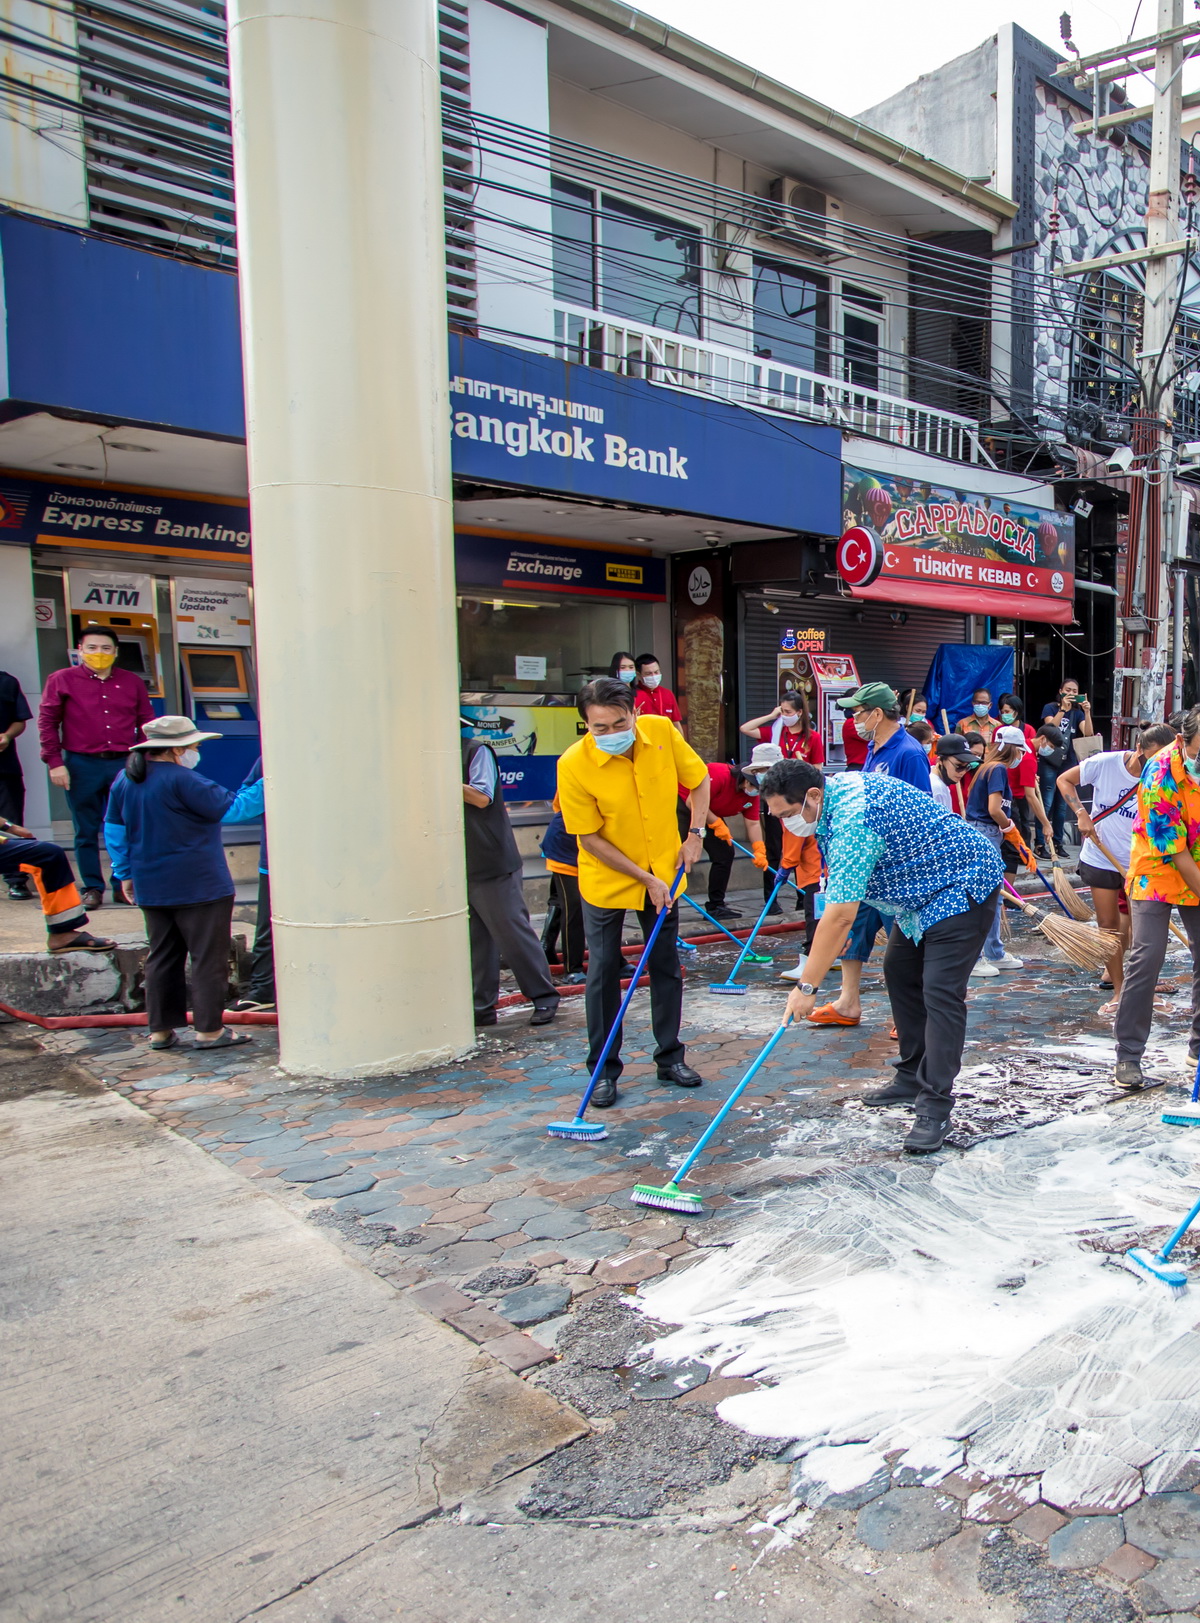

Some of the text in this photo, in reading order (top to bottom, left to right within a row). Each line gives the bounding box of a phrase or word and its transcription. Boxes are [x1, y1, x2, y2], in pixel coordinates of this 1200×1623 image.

[604, 434, 688, 479] Bank
[42, 506, 251, 548] Express Banking
[895, 503, 1036, 564] CAPPADOCIA
[506, 558, 582, 581] Exchange
[913, 554, 1021, 587] TÜRKİYE KEBAB
[84, 588, 140, 607] ATM
[181, 594, 229, 606] Passbook
[179, 602, 216, 613] Update
[797, 628, 825, 640] coffee
[797, 641, 824, 651] OPEN
[477, 721, 501, 729] MONEY
[483, 738, 517, 747] TRANSFER
